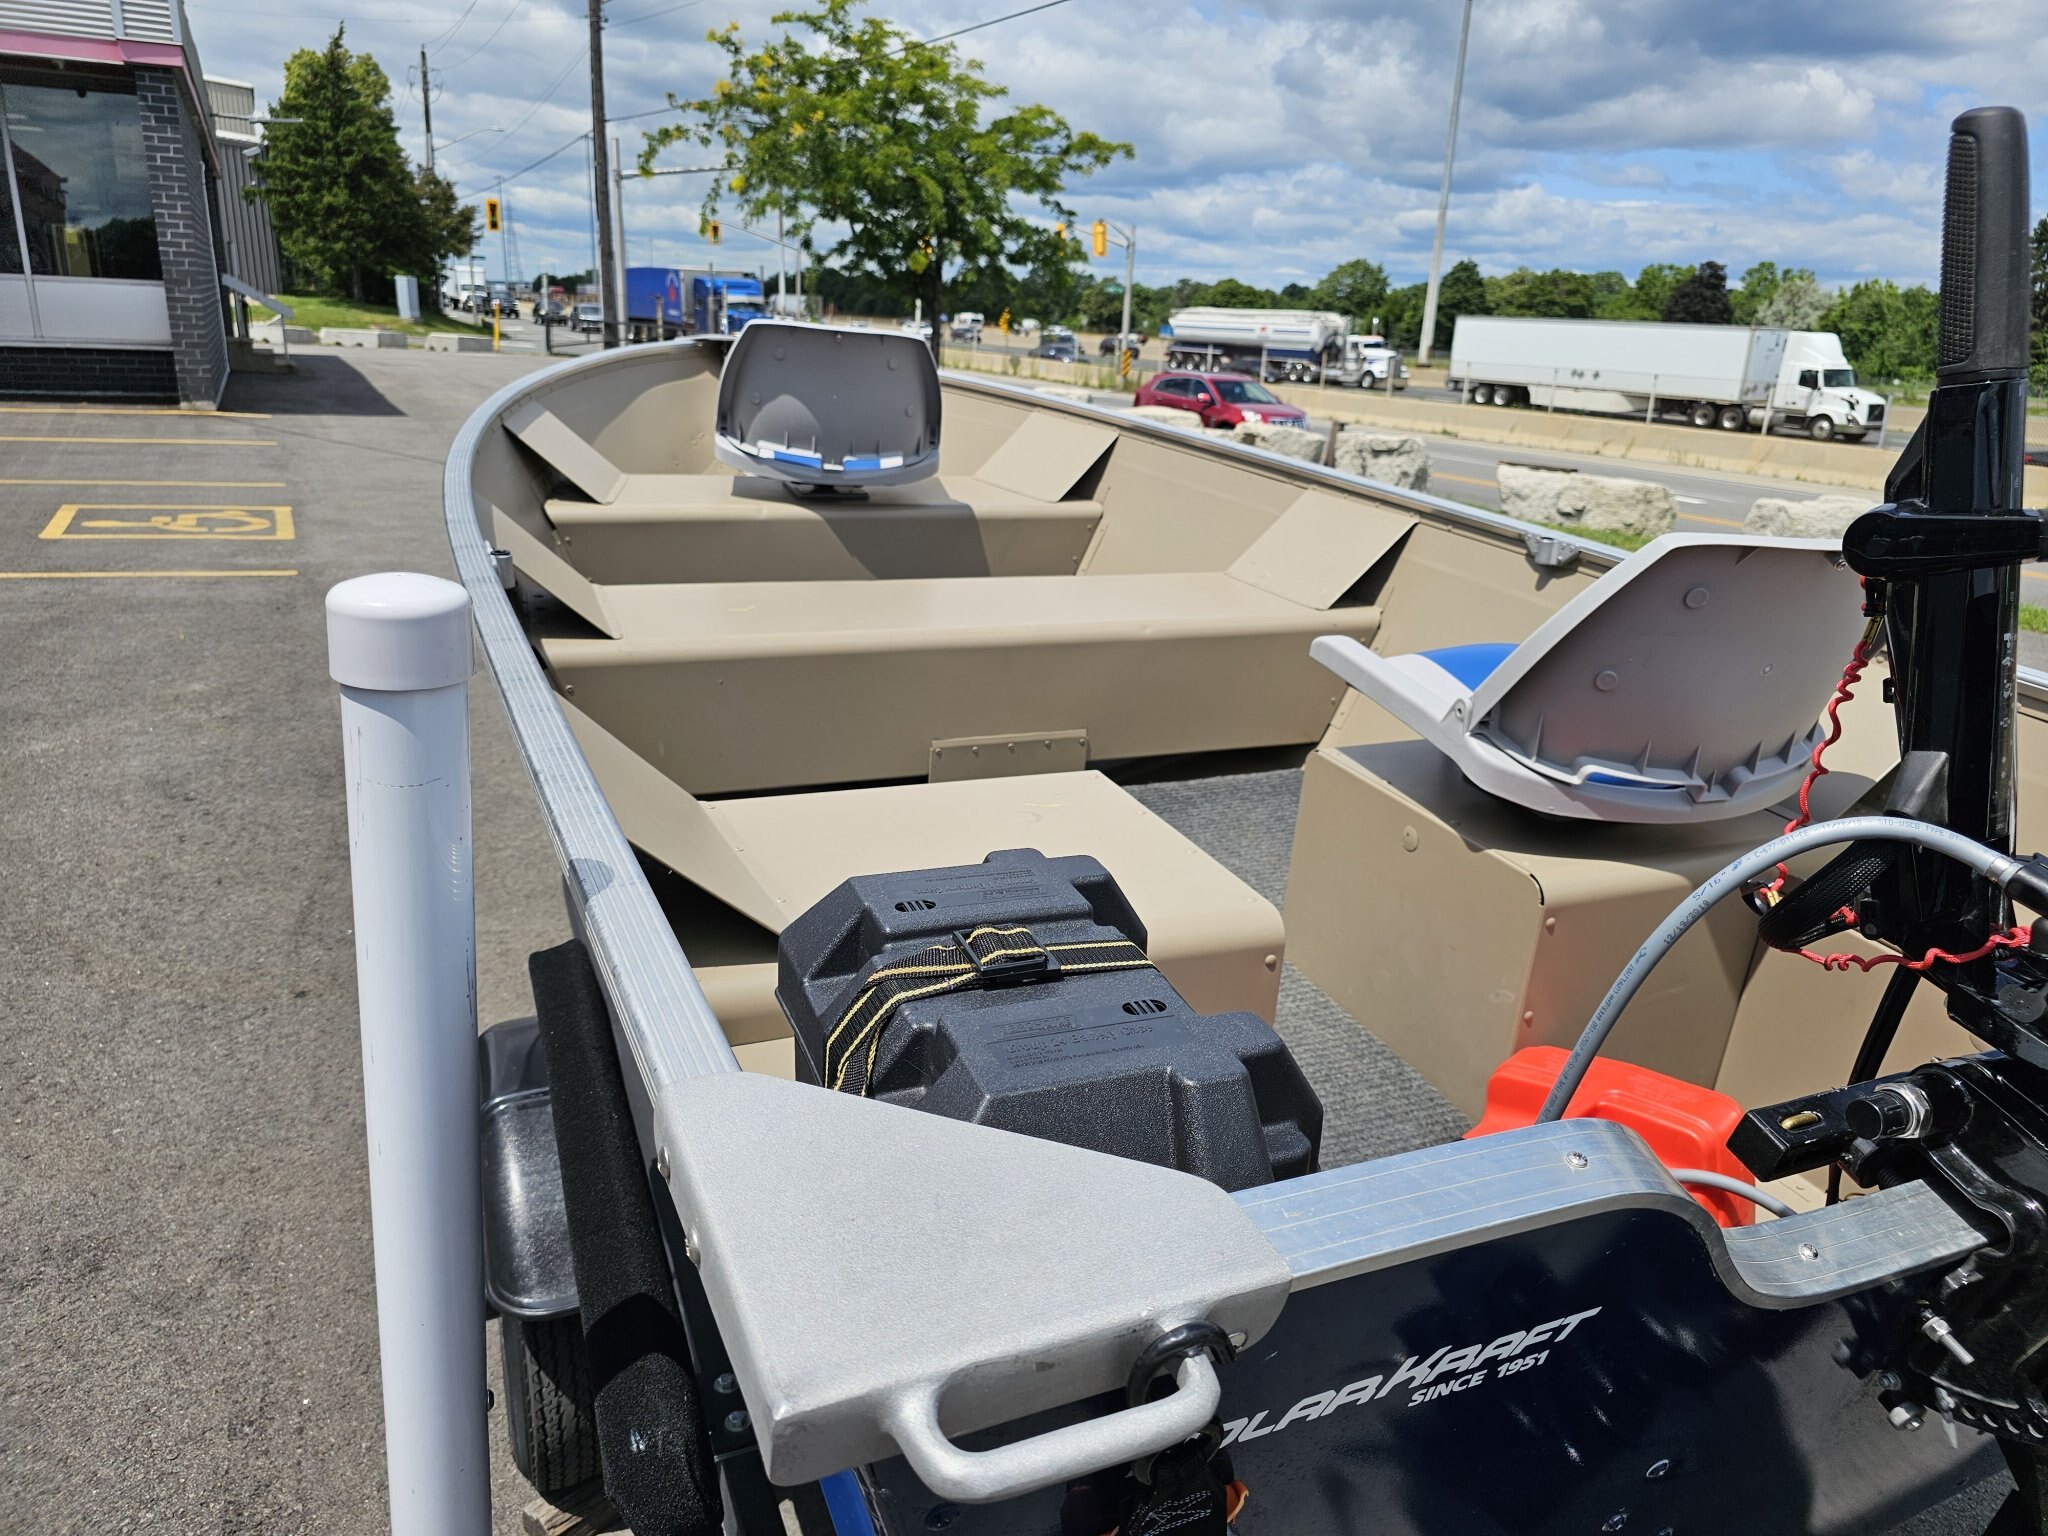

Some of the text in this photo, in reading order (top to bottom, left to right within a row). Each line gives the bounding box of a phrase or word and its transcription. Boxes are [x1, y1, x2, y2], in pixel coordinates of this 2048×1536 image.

[1218, 1306, 1603, 1450] LARKRAFT
[1408, 1350, 1551, 1408] SINCE 1951
